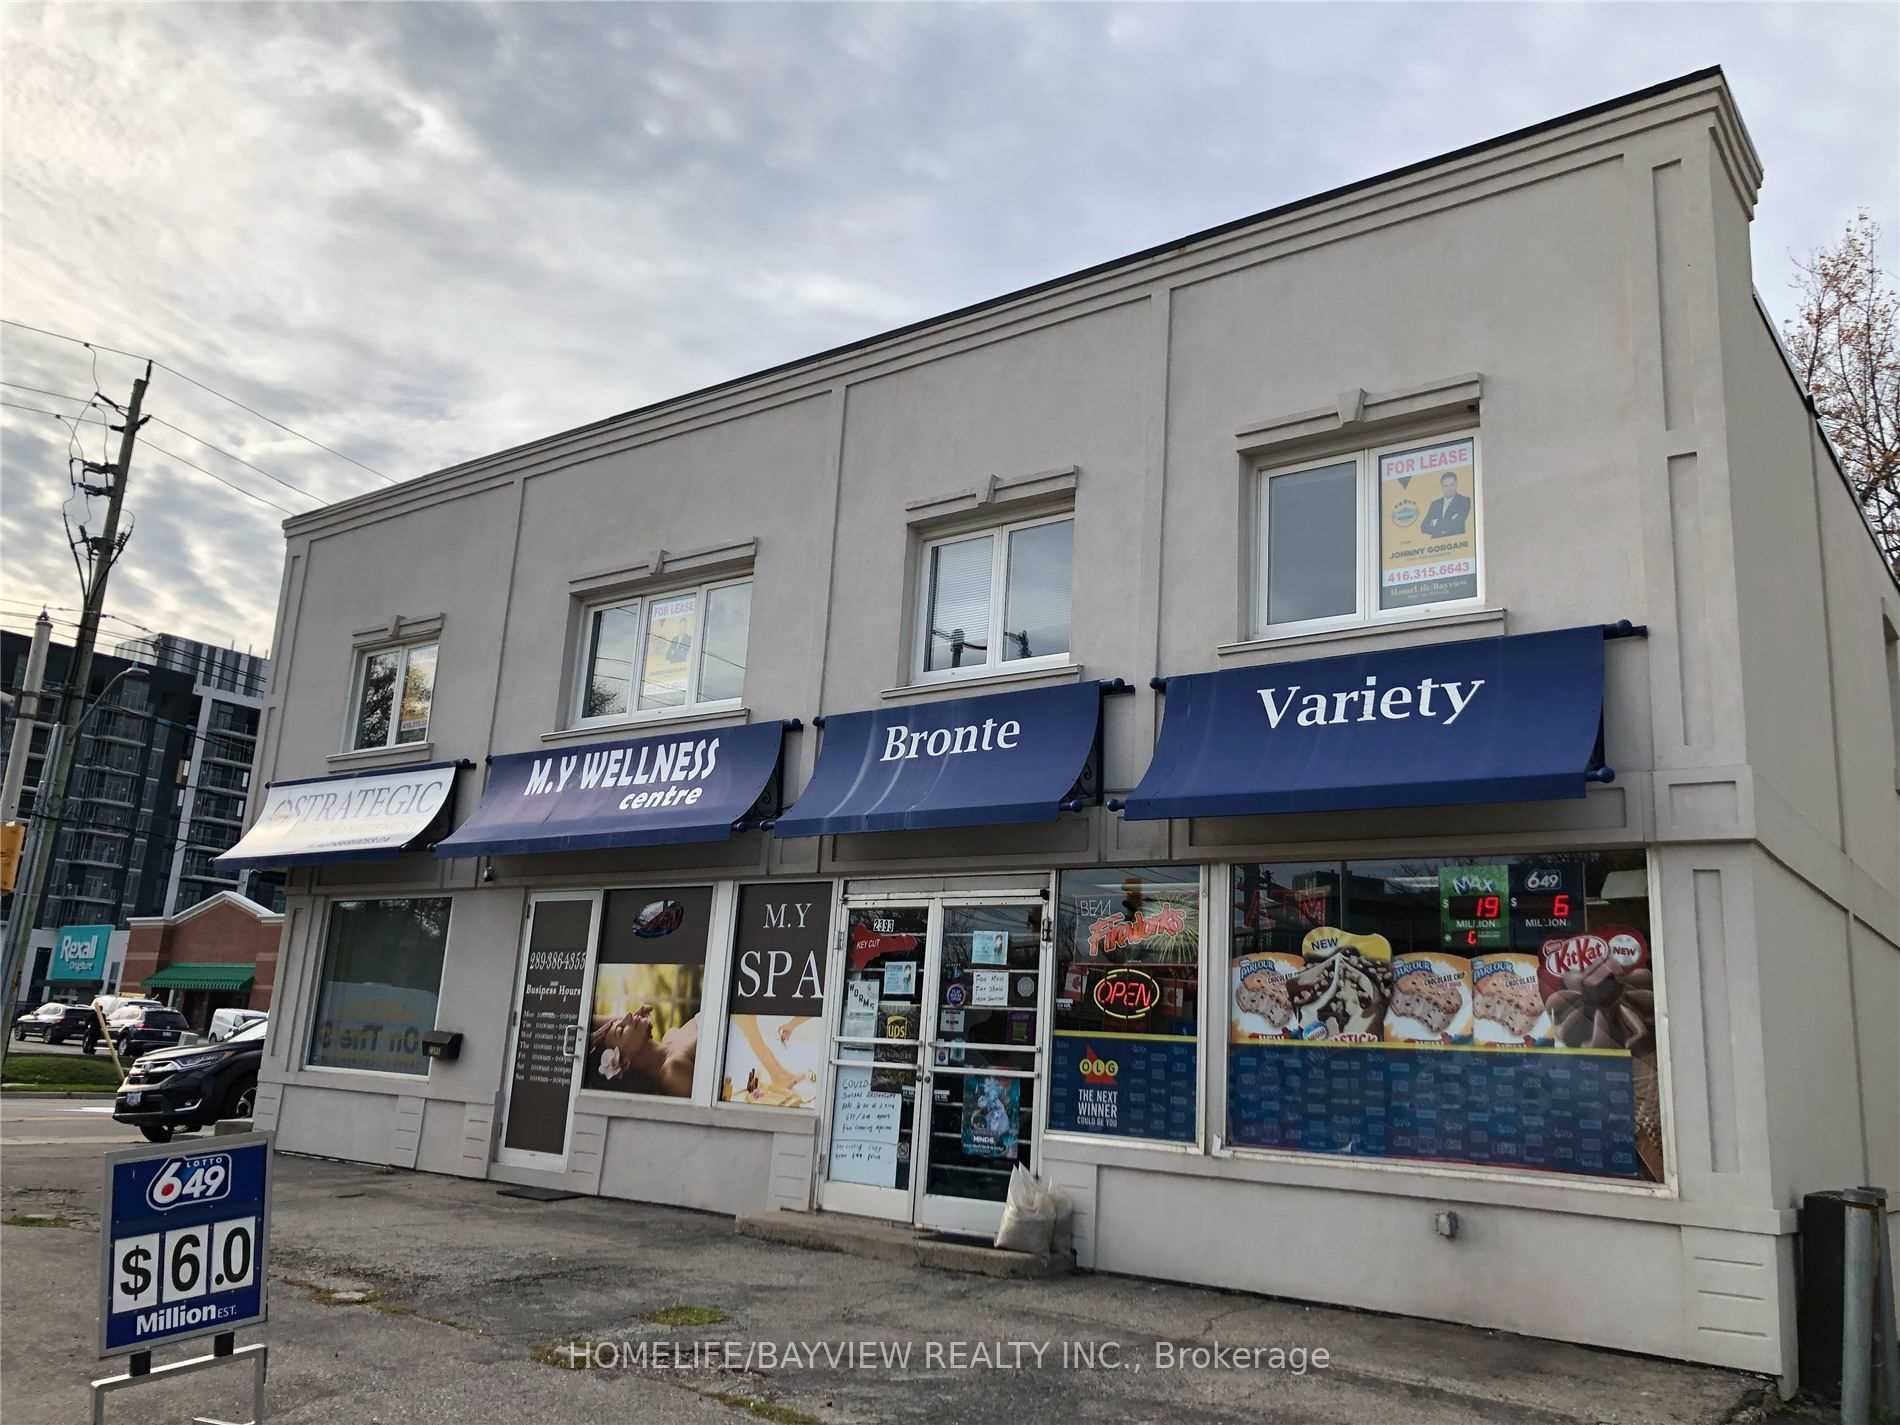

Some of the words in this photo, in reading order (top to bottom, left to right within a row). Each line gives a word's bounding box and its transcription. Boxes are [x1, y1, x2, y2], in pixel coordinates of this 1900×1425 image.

[1386, 458, 1415, 476] FOR
[1420, 448, 1468, 470] LEASE
[1256, 676, 1486, 730] Variety
[879, 717, 1021, 763] Bronte
[523, 755, 578, 797] M.Y
[580, 737, 720, 790] WELLNESS
[293, 780, 443, 824] STRATEGIC
[618, 785, 703, 811] centre
[763, 903, 813, 929] M.Y
[1476, 896, 1499, 918] 19
[1553, 895, 1568, 917] 6
[873, 920, 894, 931] 2393
[60, 935, 98, 962] Rexall
[856, 940, 867, 950] KEY
[868, 938, 880, 949] CUT
[1311, 937, 1339, 951] NEW
[1553, 938, 1603, 973] KitKat
[1612, 946, 1636, 956] NEW
[737, 950, 824, 998] SPA
[1097, 981, 1152, 1008] OPEN
[1081, 1060, 1118, 1075] OLG
[1078, 1088, 1095, 1102] THE
[1096, 1090, 1118, 1104] NEXT
[1077, 1116, 1096, 1126] COULD
[1078, 1102, 1118, 1119] WINNER
[186, 1157, 223, 1168] LOTTO
[152, 1161, 226, 1203] 649
[135, 1304, 217, 1335] Million
[217, 1304, 237, 1318] EST.
